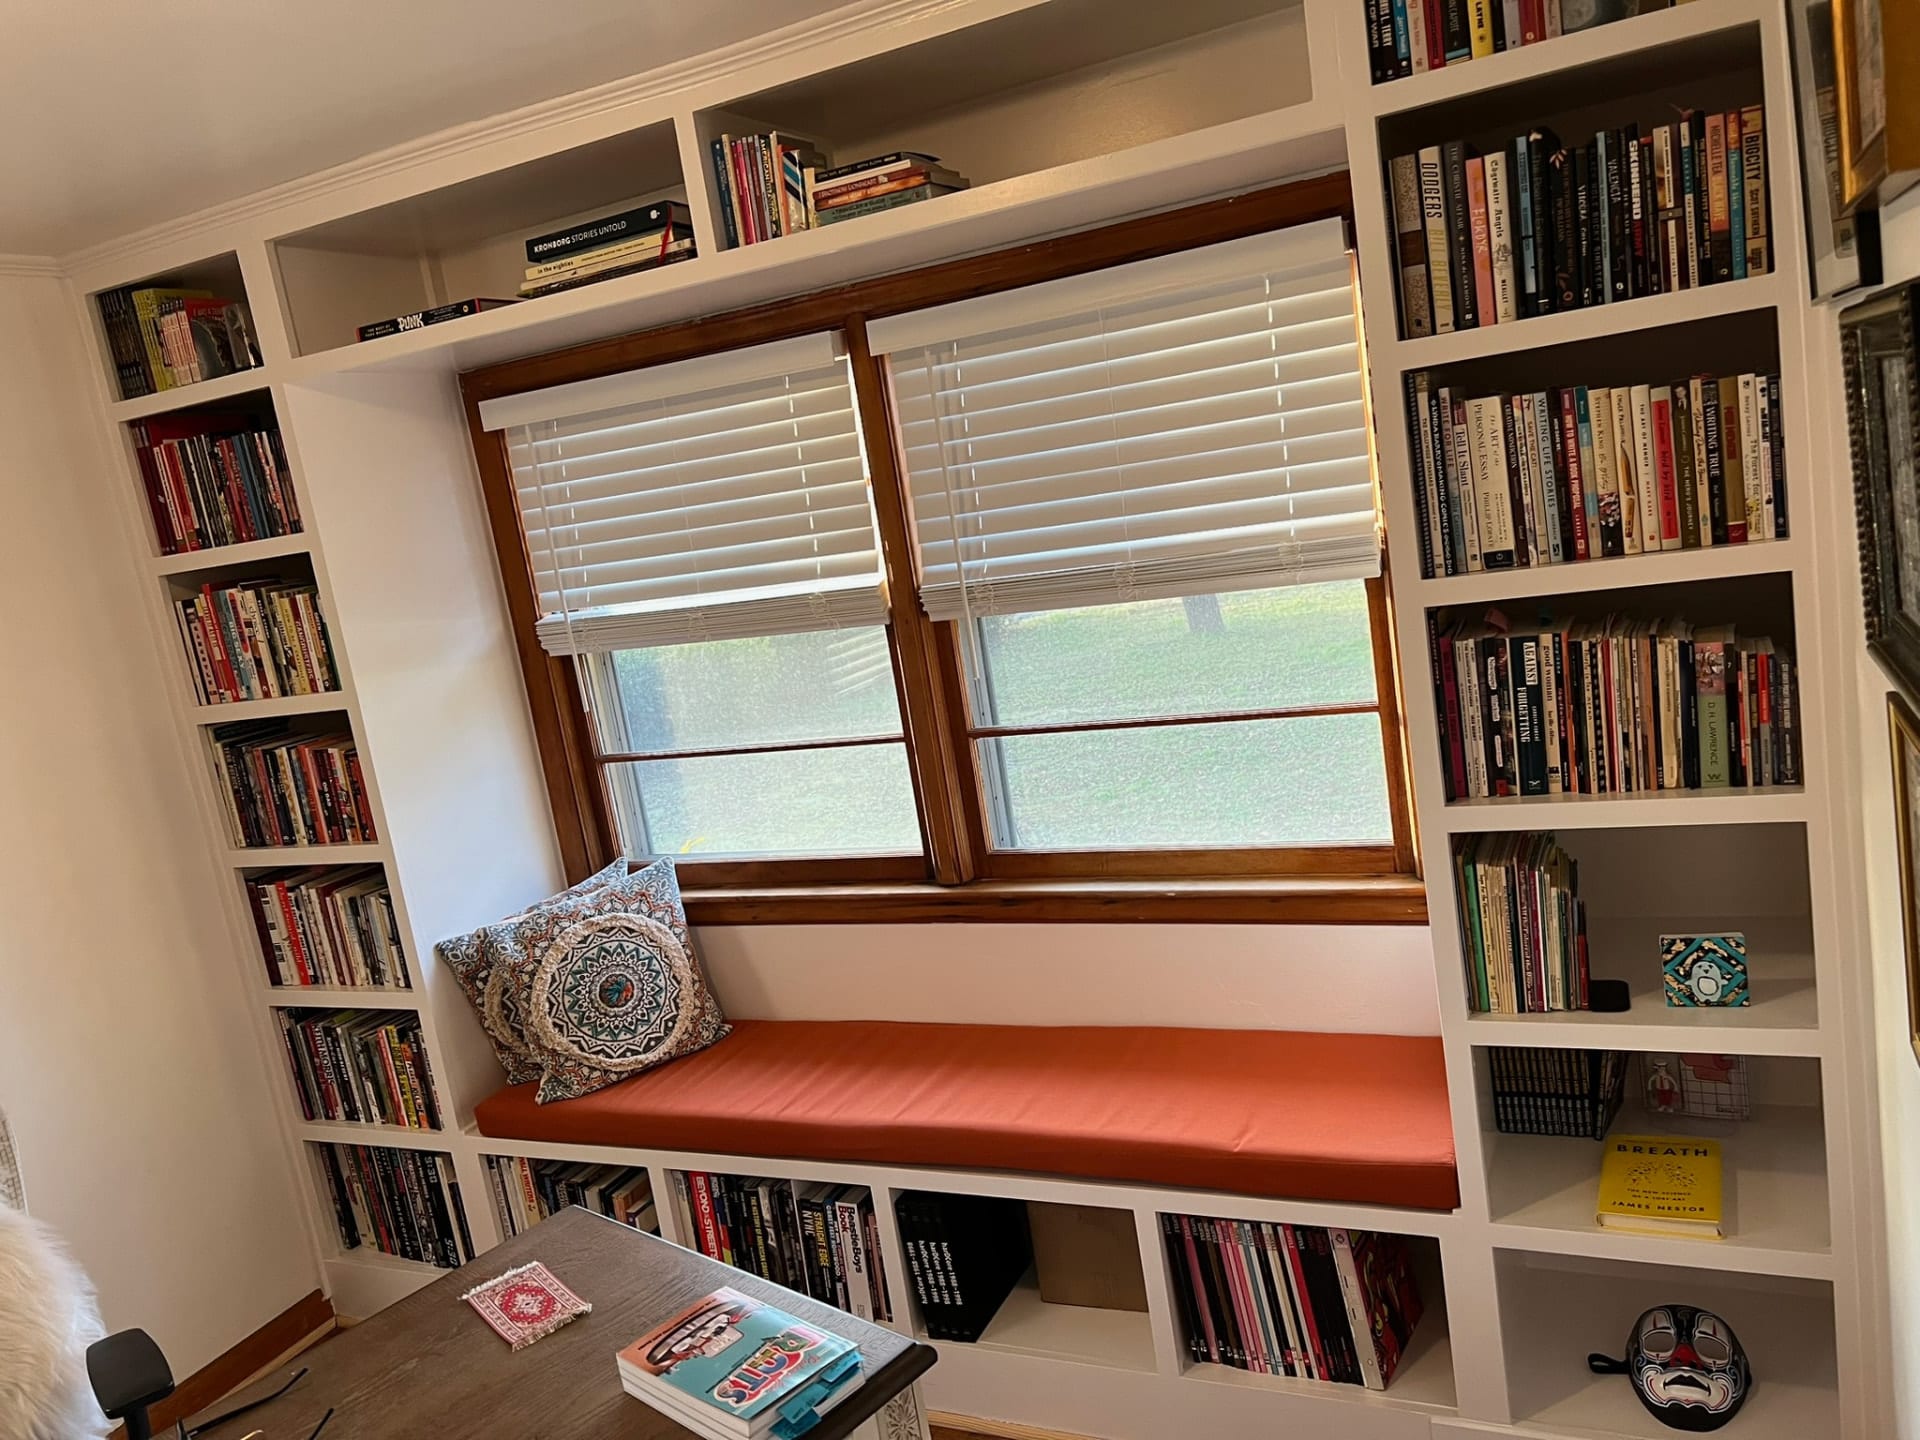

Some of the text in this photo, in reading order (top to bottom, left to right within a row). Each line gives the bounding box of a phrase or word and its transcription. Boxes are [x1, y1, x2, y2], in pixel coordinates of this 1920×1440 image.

[759, 138, 770, 180] AMERICAN
[1712, 162, 1722, 176] TEA
[1607, 159, 1622, 204] VALENCIA
[1629, 140, 1642, 220] SKINHEAD
[1490, 160, 1504, 238] Edgewater Angels
[534, 237, 571, 253] KRONBORG
[571, 228, 598, 243] STORIES
[599, 220, 627, 235] UNTOLD
[1421, 163, 1442, 218] DODGERS
[1433, 261, 1451, 311] BEVERLY
[553, 261, 574, 271] eighties
[397, 313, 425, 331] PUNK
[1431, 407, 1440, 432] LYNDA
[1441, 397, 1449, 424] WRITE
[1594, 397, 1606, 449] STEPHEN KING
[1474, 404, 1489, 481] PERSONAL ESSAY
[1489, 428, 1500, 448] ART
[1566, 430, 1574, 438] TO
[1642, 432, 1647, 440] OF
[1705, 407, 1719, 449] WRITING
[1455, 429, 1469, 486] Tell It Slant
[1538, 399, 1555, 508] WRITING LIFE STORIES
[1567, 439, 1576, 457] WRITE
[1751, 440, 1759, 453] The
[1569, 463, 1578, 479] BOOK
[1709, 452, 1720, 478] TRUE
[1751, 456, 1760, 480] Forest
[1436, 466, 1446, 500] MAKING
[1571, 480, 1581, 509] PROPOSAL
[1752, 483, 1760, 495] for
[1439, 503, 1449, 533] COMICS
[1482, 491, 1490, 518] PHILLIP
[1686, 503, 1694, 530] JOURNEY
[229, 622, 245, 669] BIG SEXY
[1543, 646, 1552, 667] good
[1524, 644, 1537, 683] AGAINST
[1517, 687, 1530, 742] FORGETTING
[1709, 722, 1718, 765] LAWRENCE
[318, 1048, 335, 1084] MORRIS
[1616, 1144, 1709, 1157] BREATH
[423, 1155, 458, 1266] 9:30 9:30
[696, 1176, 719, 1260] BEYOND STREETS
[838, 1206, 850, 1233] Book
[1612, 1200, 1705, 1212] JAMES NESTOR
[751, 1207, 761, 1227] HISTORY
[757, 1236, 766, 1261] AMERICAN
[802, 1210, 815, 1237] NYHC
[813, 1211, 830, 1267] STRAIGHT EDGE
[846, 1207, 863, 1273] Beastie Boys
[714, 1331, 810, 1403] RATS
